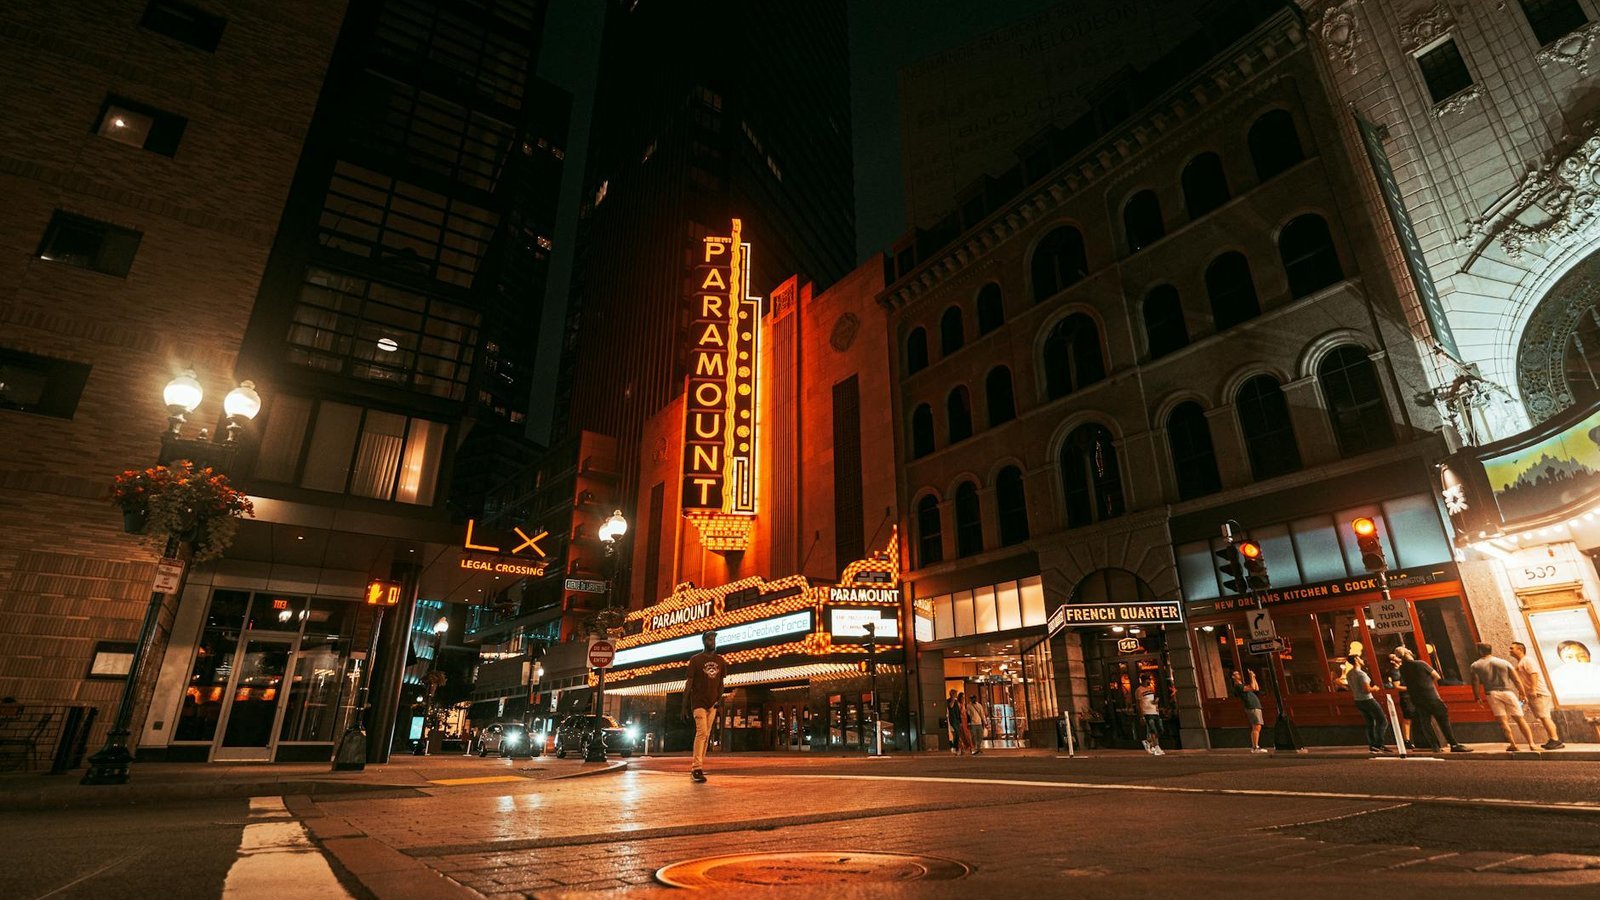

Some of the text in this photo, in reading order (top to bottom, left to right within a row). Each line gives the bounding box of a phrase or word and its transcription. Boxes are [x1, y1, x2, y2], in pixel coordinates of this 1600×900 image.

[1018, 3, 1139, 60] MELODEON
[1386, 177, 1452, 344] OPERA HOUSE
[693, 242, 726, 506] PARAMOUNT
[461, 559, 544, 576] LEGAL CROSSING
[830, 588, 899, 602] PARAMOUNT
[1214, 600, 1234, 611] NEW
[1238, 593, 1280, 606] ORLANS
[1283, 586, 1328, 600] KITCHEN
[1331, 584, 1340, 594] &
[1066, 606, 1178, 621] FRENCH QUARTER
[1381, 604, 1395, 612] NO
[652, 602, 712, 630] PARAMOUNT
[1380, 611, 1404, 620] TURN
[781, 619, 808, 633] Force
[1376, 619, 1410, 629] ON RED
[1254, 629, 1270, 638] ONLY
[1120, 641, 1137, 650] 545
